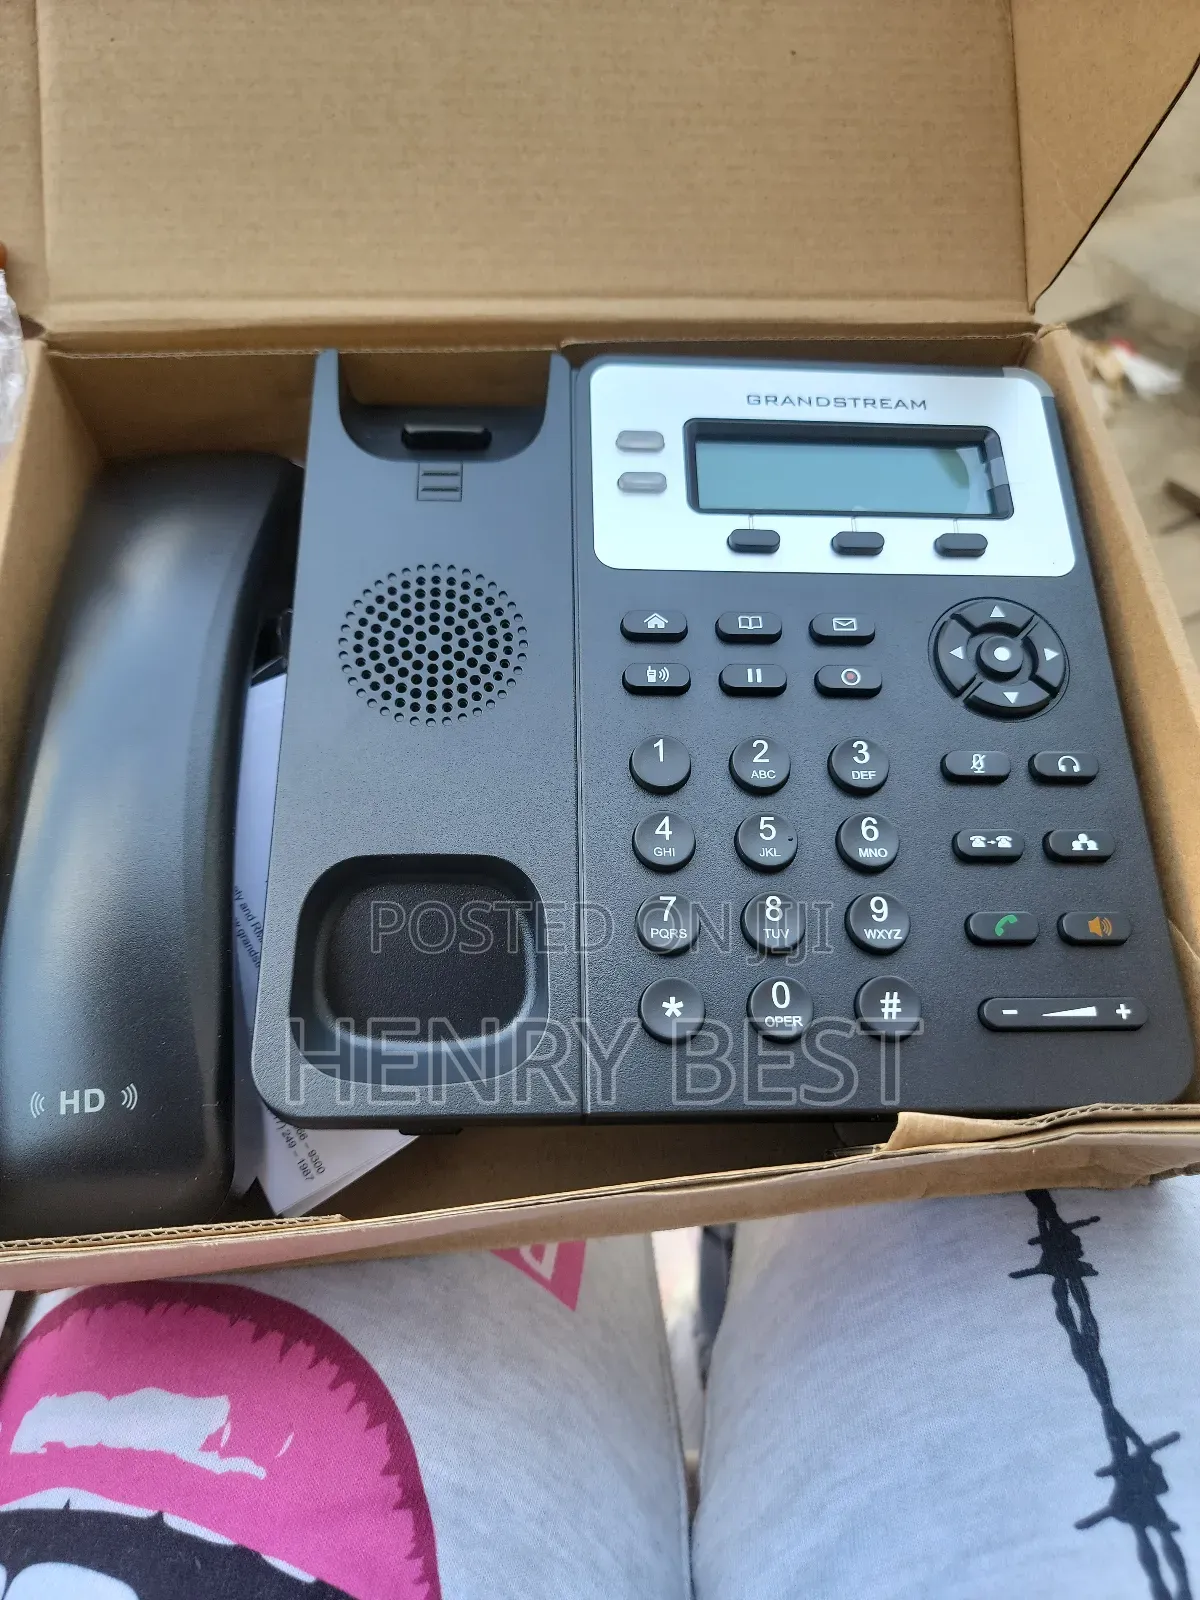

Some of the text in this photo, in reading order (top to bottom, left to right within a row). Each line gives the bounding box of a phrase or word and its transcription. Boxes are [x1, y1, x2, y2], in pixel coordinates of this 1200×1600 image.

[746, 393, 928, 411] GRANDSTREAM
[652, 738, 665, 763] 1
[751, 738, 770, 763] 2
[851, 740, 870, 764] 3
[750, 769, 777, 780] ABC
[851, 770, 877, 780] DEF
[654, 815, 673, 841] 4
[758, 816, 777, 841] 5
[861, 816, 880, 842] 6
[652, 846, 676, 857] GHI
[758, 847, 782, 858] JKL
[858, 847, 889, 858] MNO
[240, 903, 256, 921] and
[659, 895, 678, 922] 7
[764, 895, 784, 922] 8
[868, 896, 889, 923] 9
[650, 927, 688, 941] PQRS
[762, 928, 791, 940] TUV
[863, 928, 903, 940] WXYZ
[771, 981, 791, 1009] 0
[879, 991, 902, 1020] #
[764, 1015, 804, 1028] OPER
[59, 1088, 105, 1115] HD
[281, 1129, 297, 1149] 249
[297, 1158, 315, 1181] 1987
[307, 1149, 326, 1175] 9300
